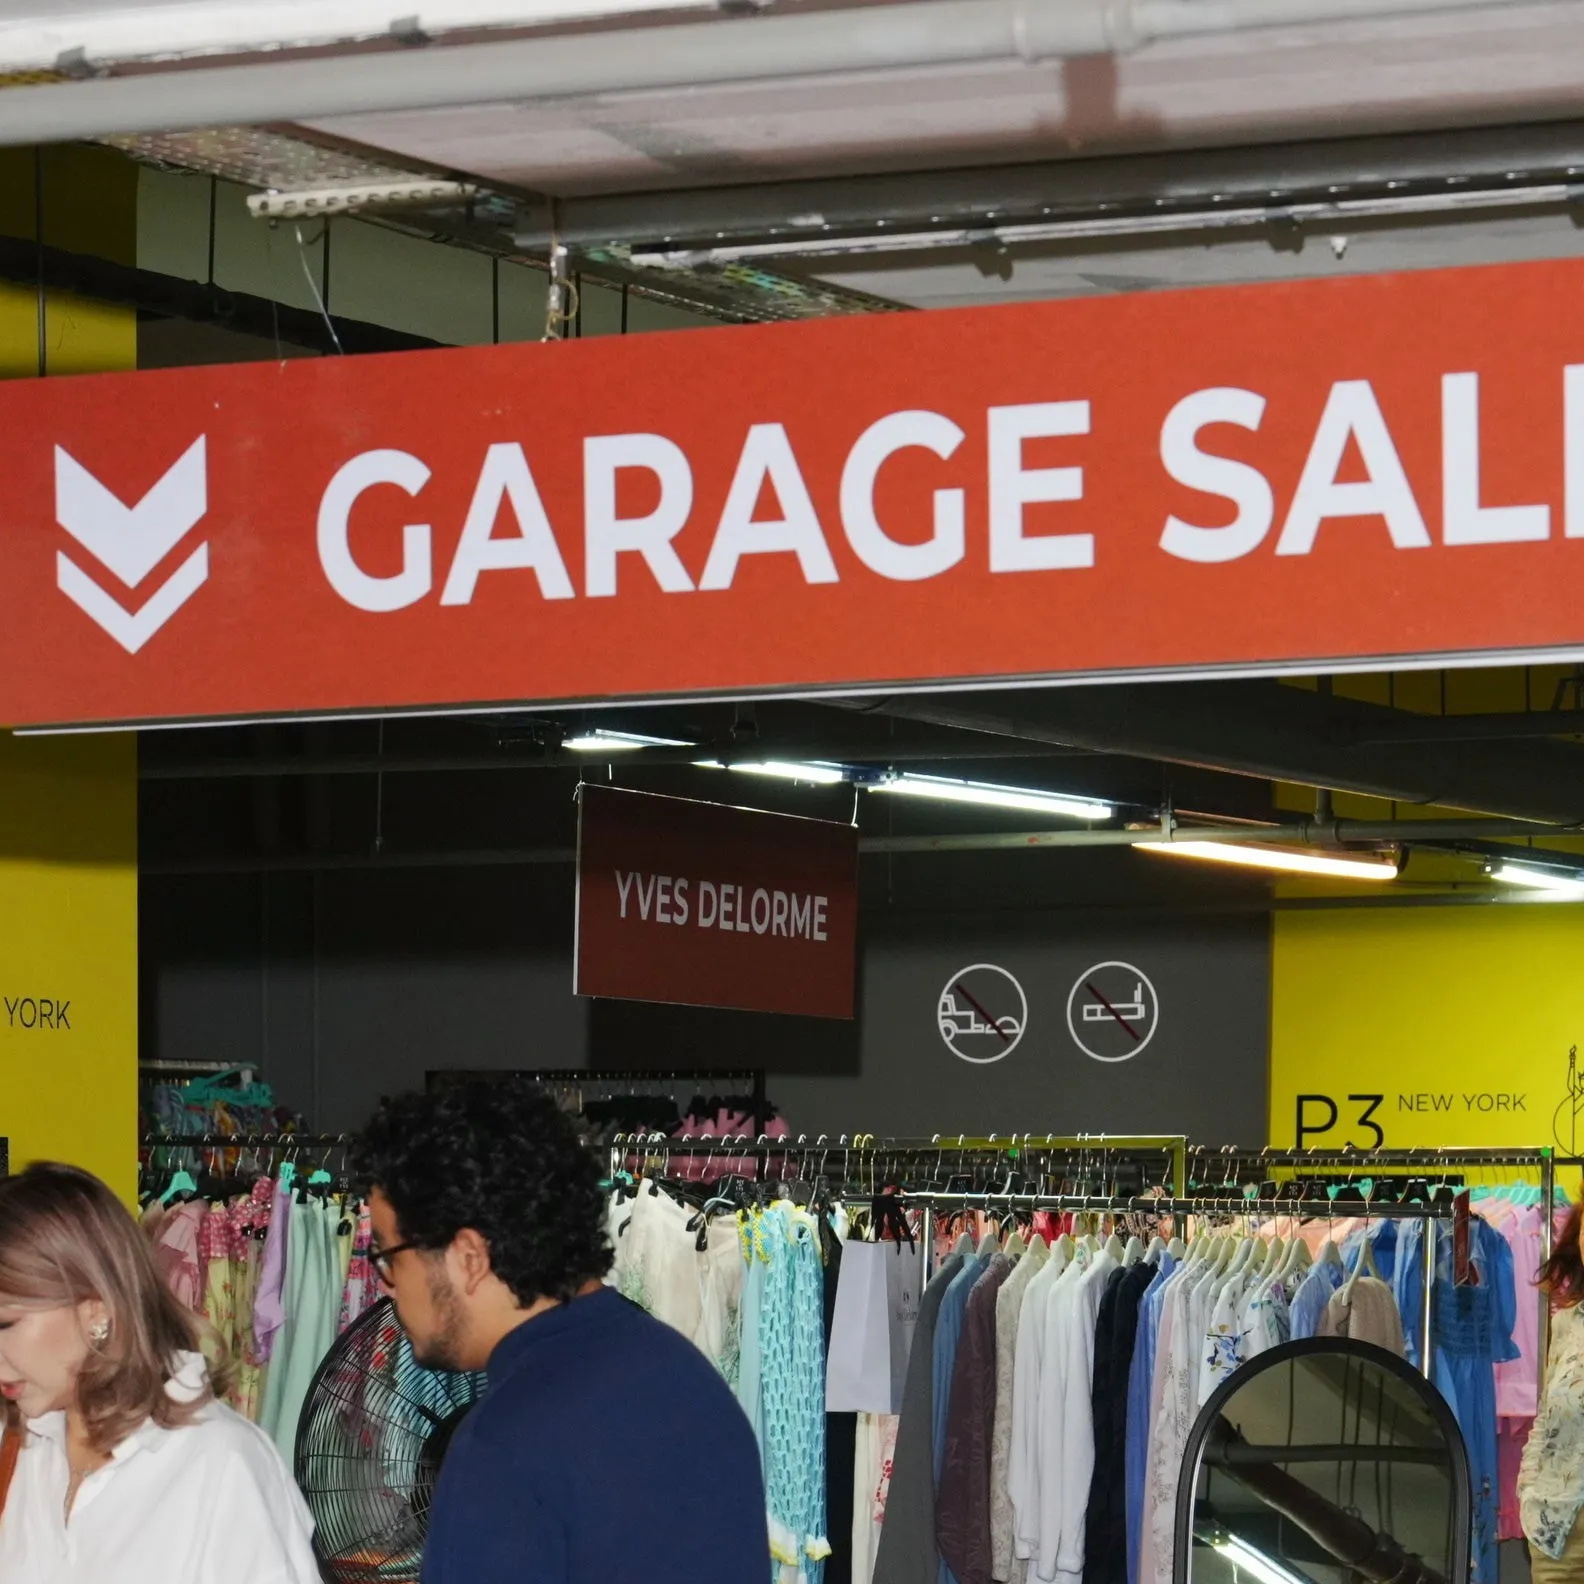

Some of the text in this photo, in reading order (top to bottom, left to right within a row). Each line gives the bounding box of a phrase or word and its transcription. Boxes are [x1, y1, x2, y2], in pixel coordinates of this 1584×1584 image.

[316, 399, 1095, 613] GARAGE
[615, 869, 829, 942] YVES DELORME
[5, 997, 72, 1031] YORK
[1296, 1093, 1527, 1149] P3 NEW YORK
